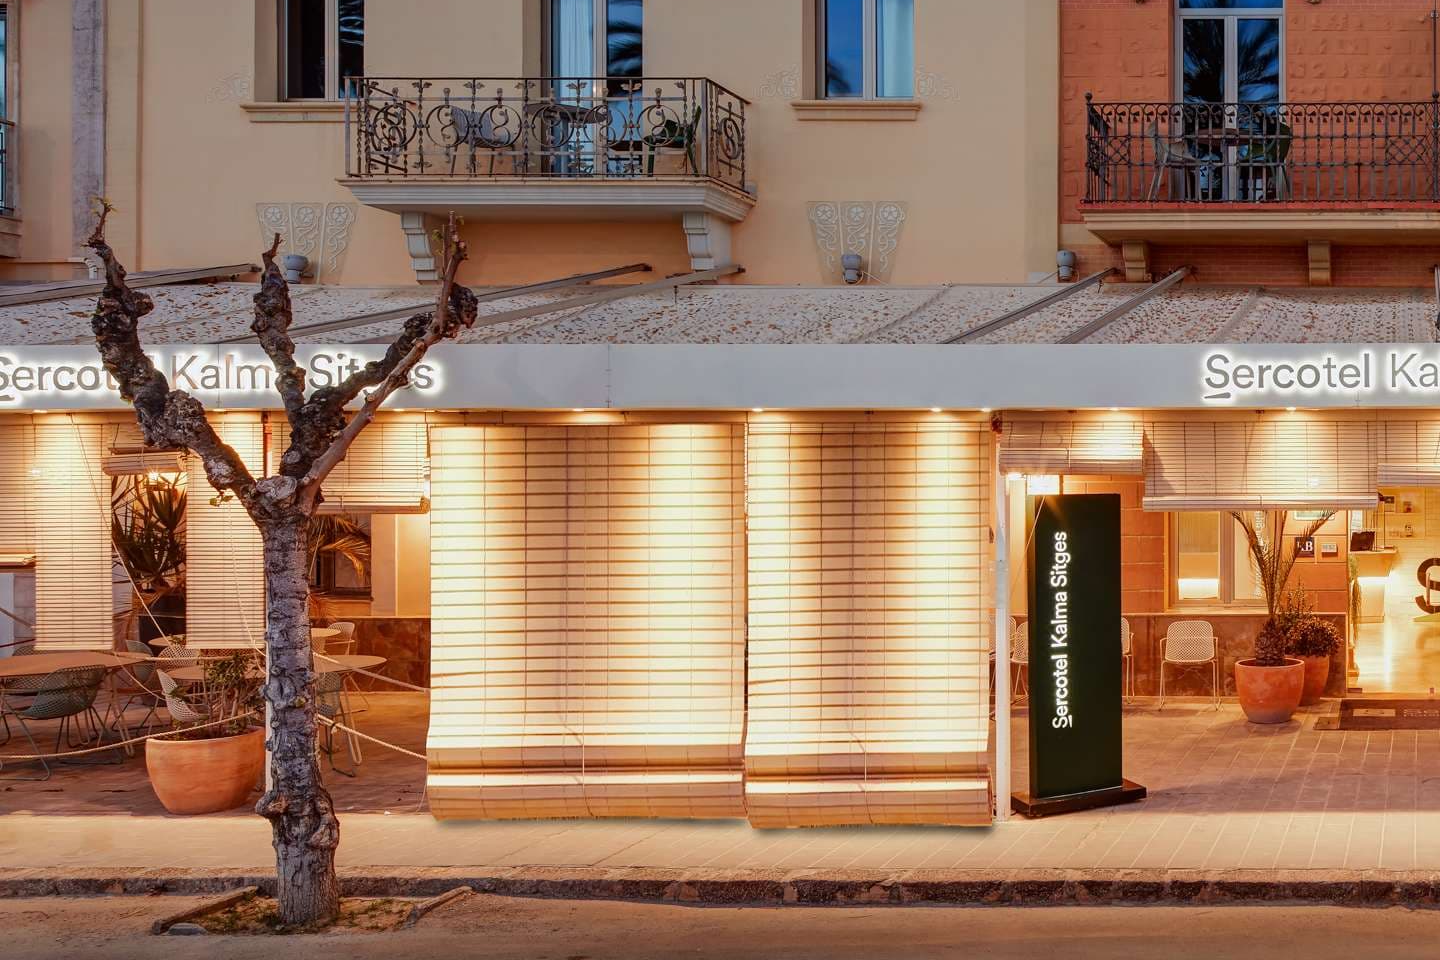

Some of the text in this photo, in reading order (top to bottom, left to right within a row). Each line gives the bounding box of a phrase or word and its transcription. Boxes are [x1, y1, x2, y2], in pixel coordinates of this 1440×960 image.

[172, 354, 280, 389] Kalm
[1204, 352, 1370, 399] Sercotel
[1050, 531, 1072, 729] Sercotel Kalma Sitges
